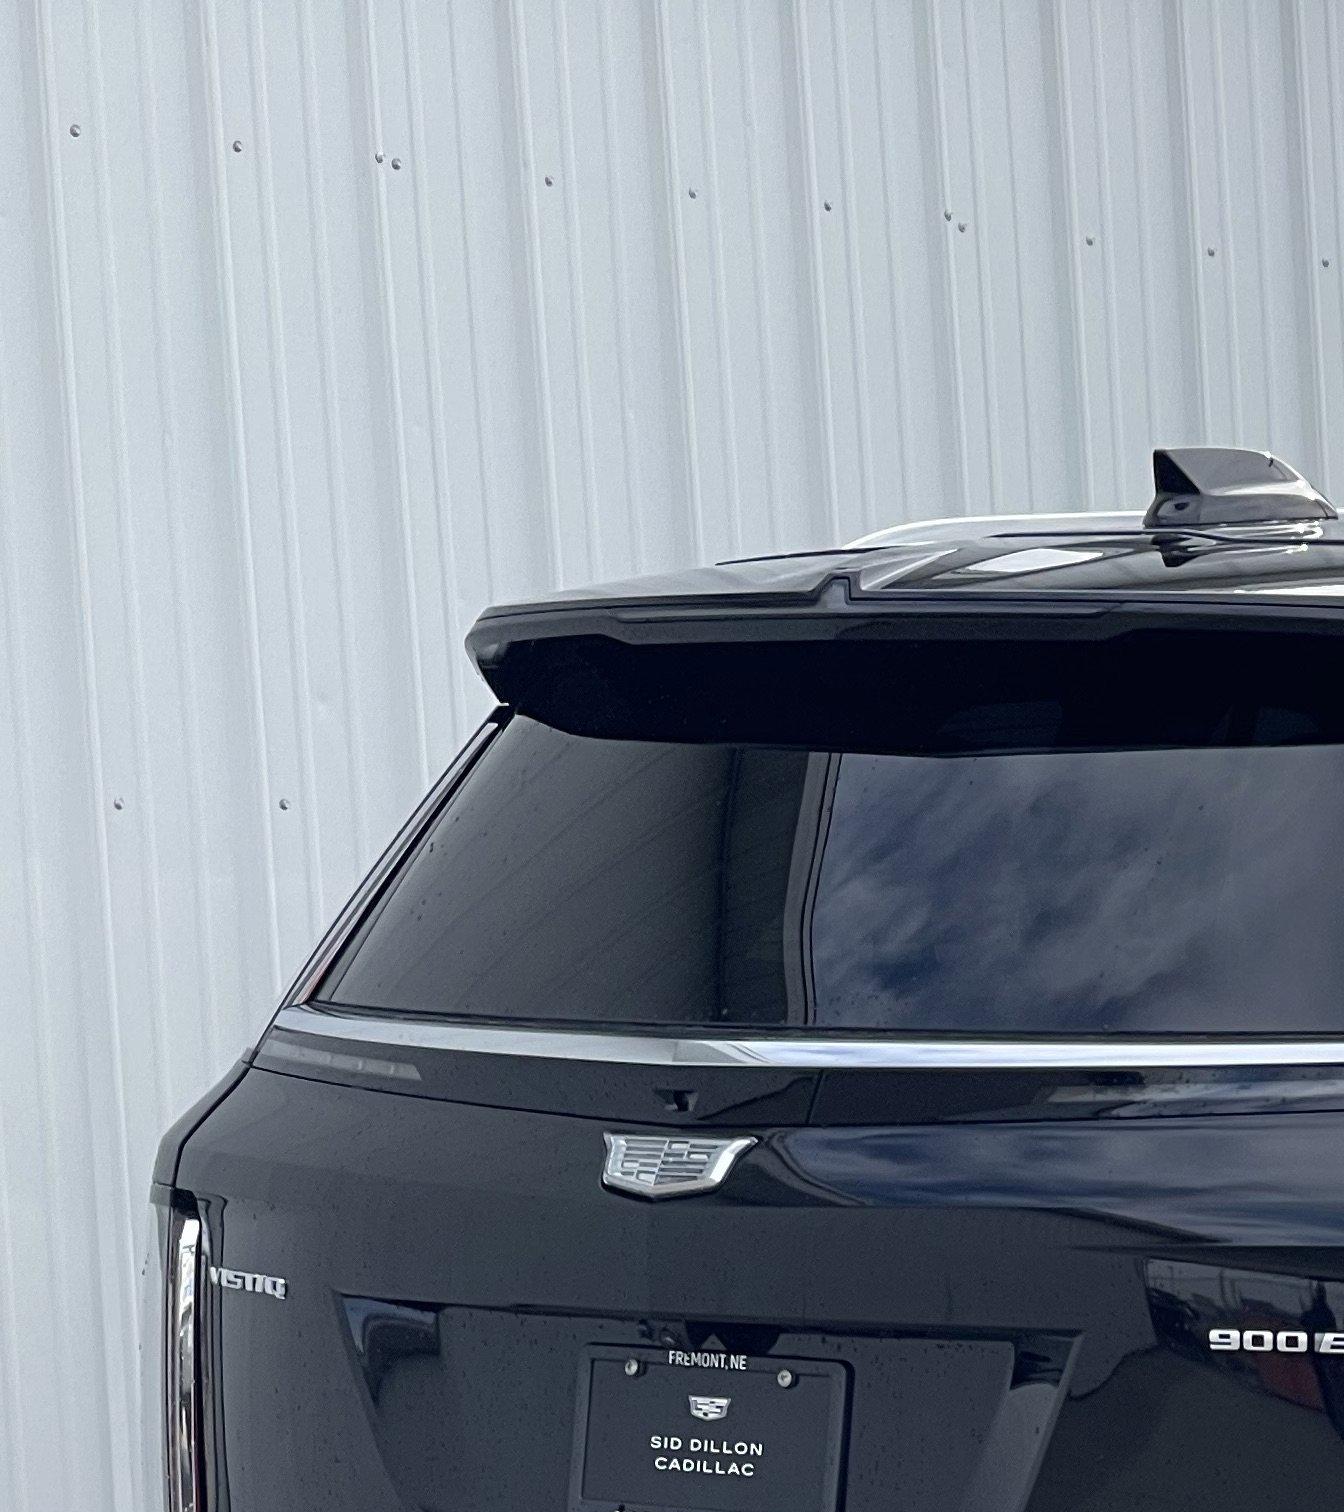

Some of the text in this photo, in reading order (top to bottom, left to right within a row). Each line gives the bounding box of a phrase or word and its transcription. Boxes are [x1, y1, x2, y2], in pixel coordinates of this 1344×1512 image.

[209, 1266, 286, 1300] VISTIQ
[1208, 1328, 1308, 1353] 900
[650, 1435, 763, 1456] SID DILLON
[654, 1456, 755, 1477] CADILLAC
